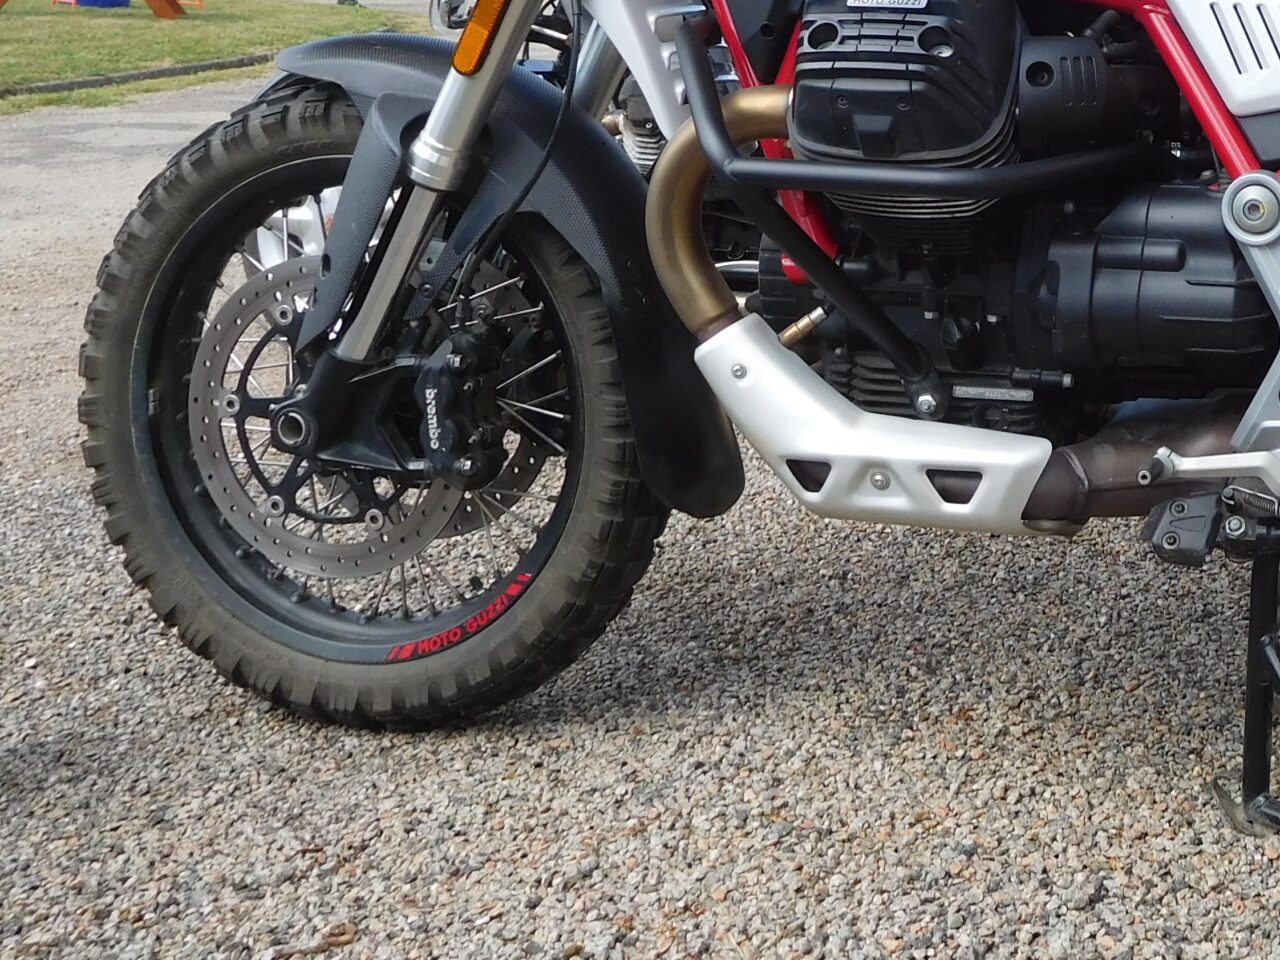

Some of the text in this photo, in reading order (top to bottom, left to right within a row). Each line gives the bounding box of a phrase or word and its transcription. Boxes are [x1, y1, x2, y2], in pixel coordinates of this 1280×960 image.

[425, 388, 441, 450] brembo
[417, 594, 509, 655] MOTO GUZZI
